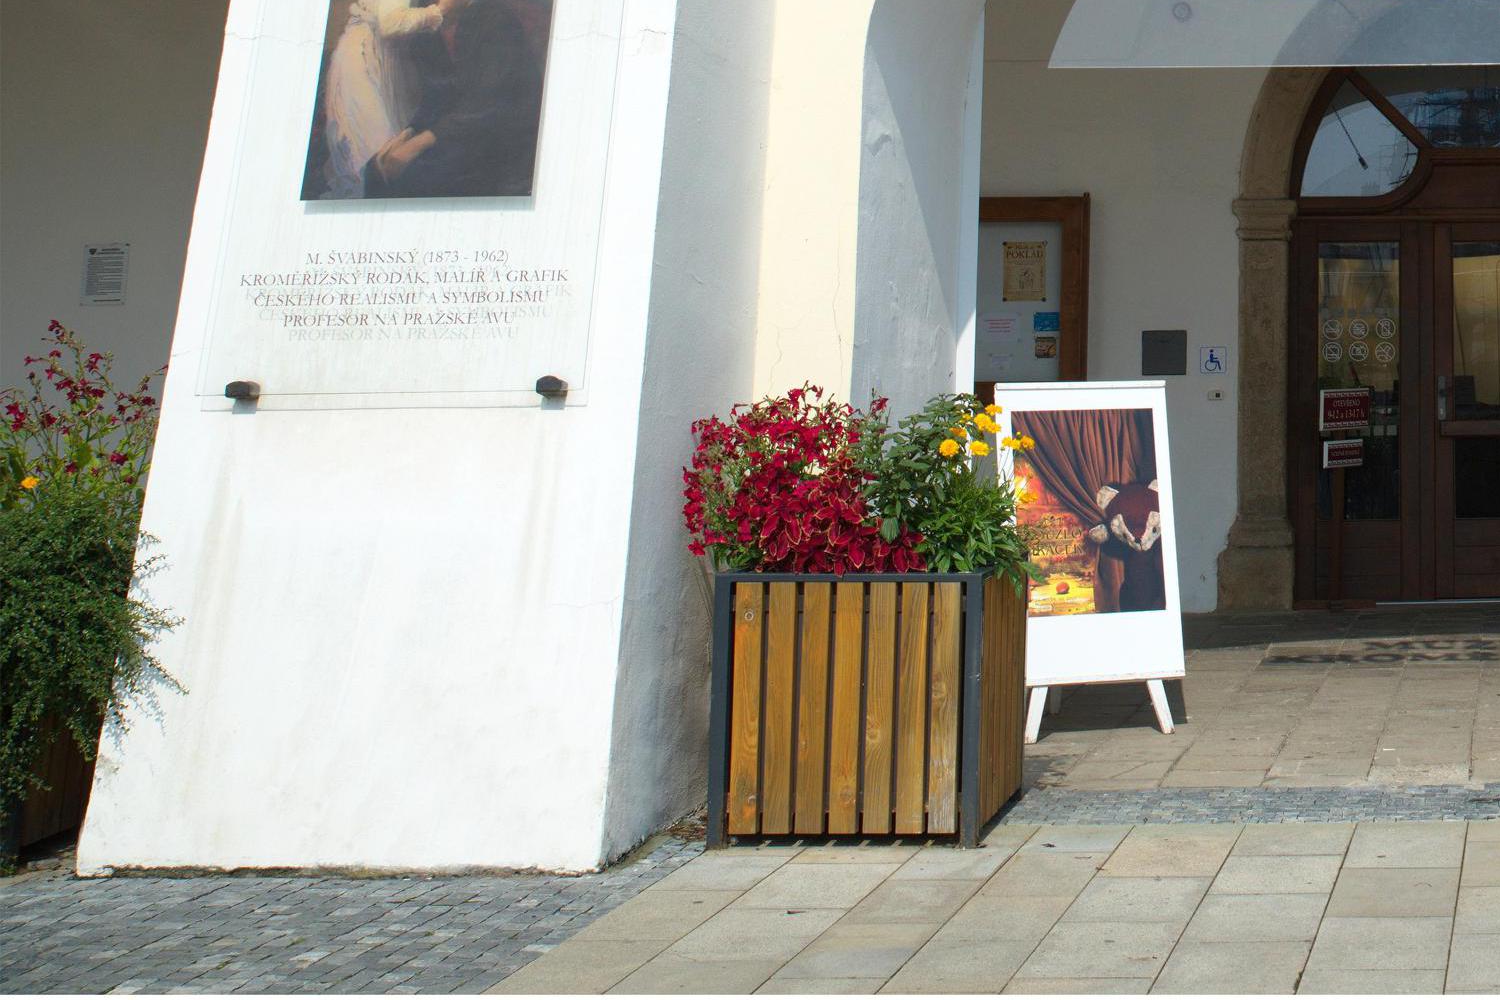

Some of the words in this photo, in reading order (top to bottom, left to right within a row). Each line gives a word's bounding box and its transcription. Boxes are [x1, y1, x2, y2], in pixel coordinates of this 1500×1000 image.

[305, 252, 323, 265] M.
[327, 249, 419, 264] ŠVABINSKÝ
[423, 250, 460, 265] (1873
[474, 249, 509, 265] 1962)
[240, 270, 362, 286] KROMĚŘÍŽSKÝ
[366, 268, 430, 285] RODÁK,
[434, 267, 486, 283] MALÍŘ
[491, 270, 501, 282] A
[505, 269, 569, 282] GRAFIK
[254, 291, 335, 306] ČESKÉHO
[339, 292, 420, 306] REALISMU
[427, 292, 437, 304] A
[441, 290, 548, 304] SYMBOLISMU
[283, 313, 369, 327] PROFESOR
[374, 313, 397, 326] NA
[403, 310, 478, 325] PRAŽSKÉ
[481, 311, 516, 324] AVU
